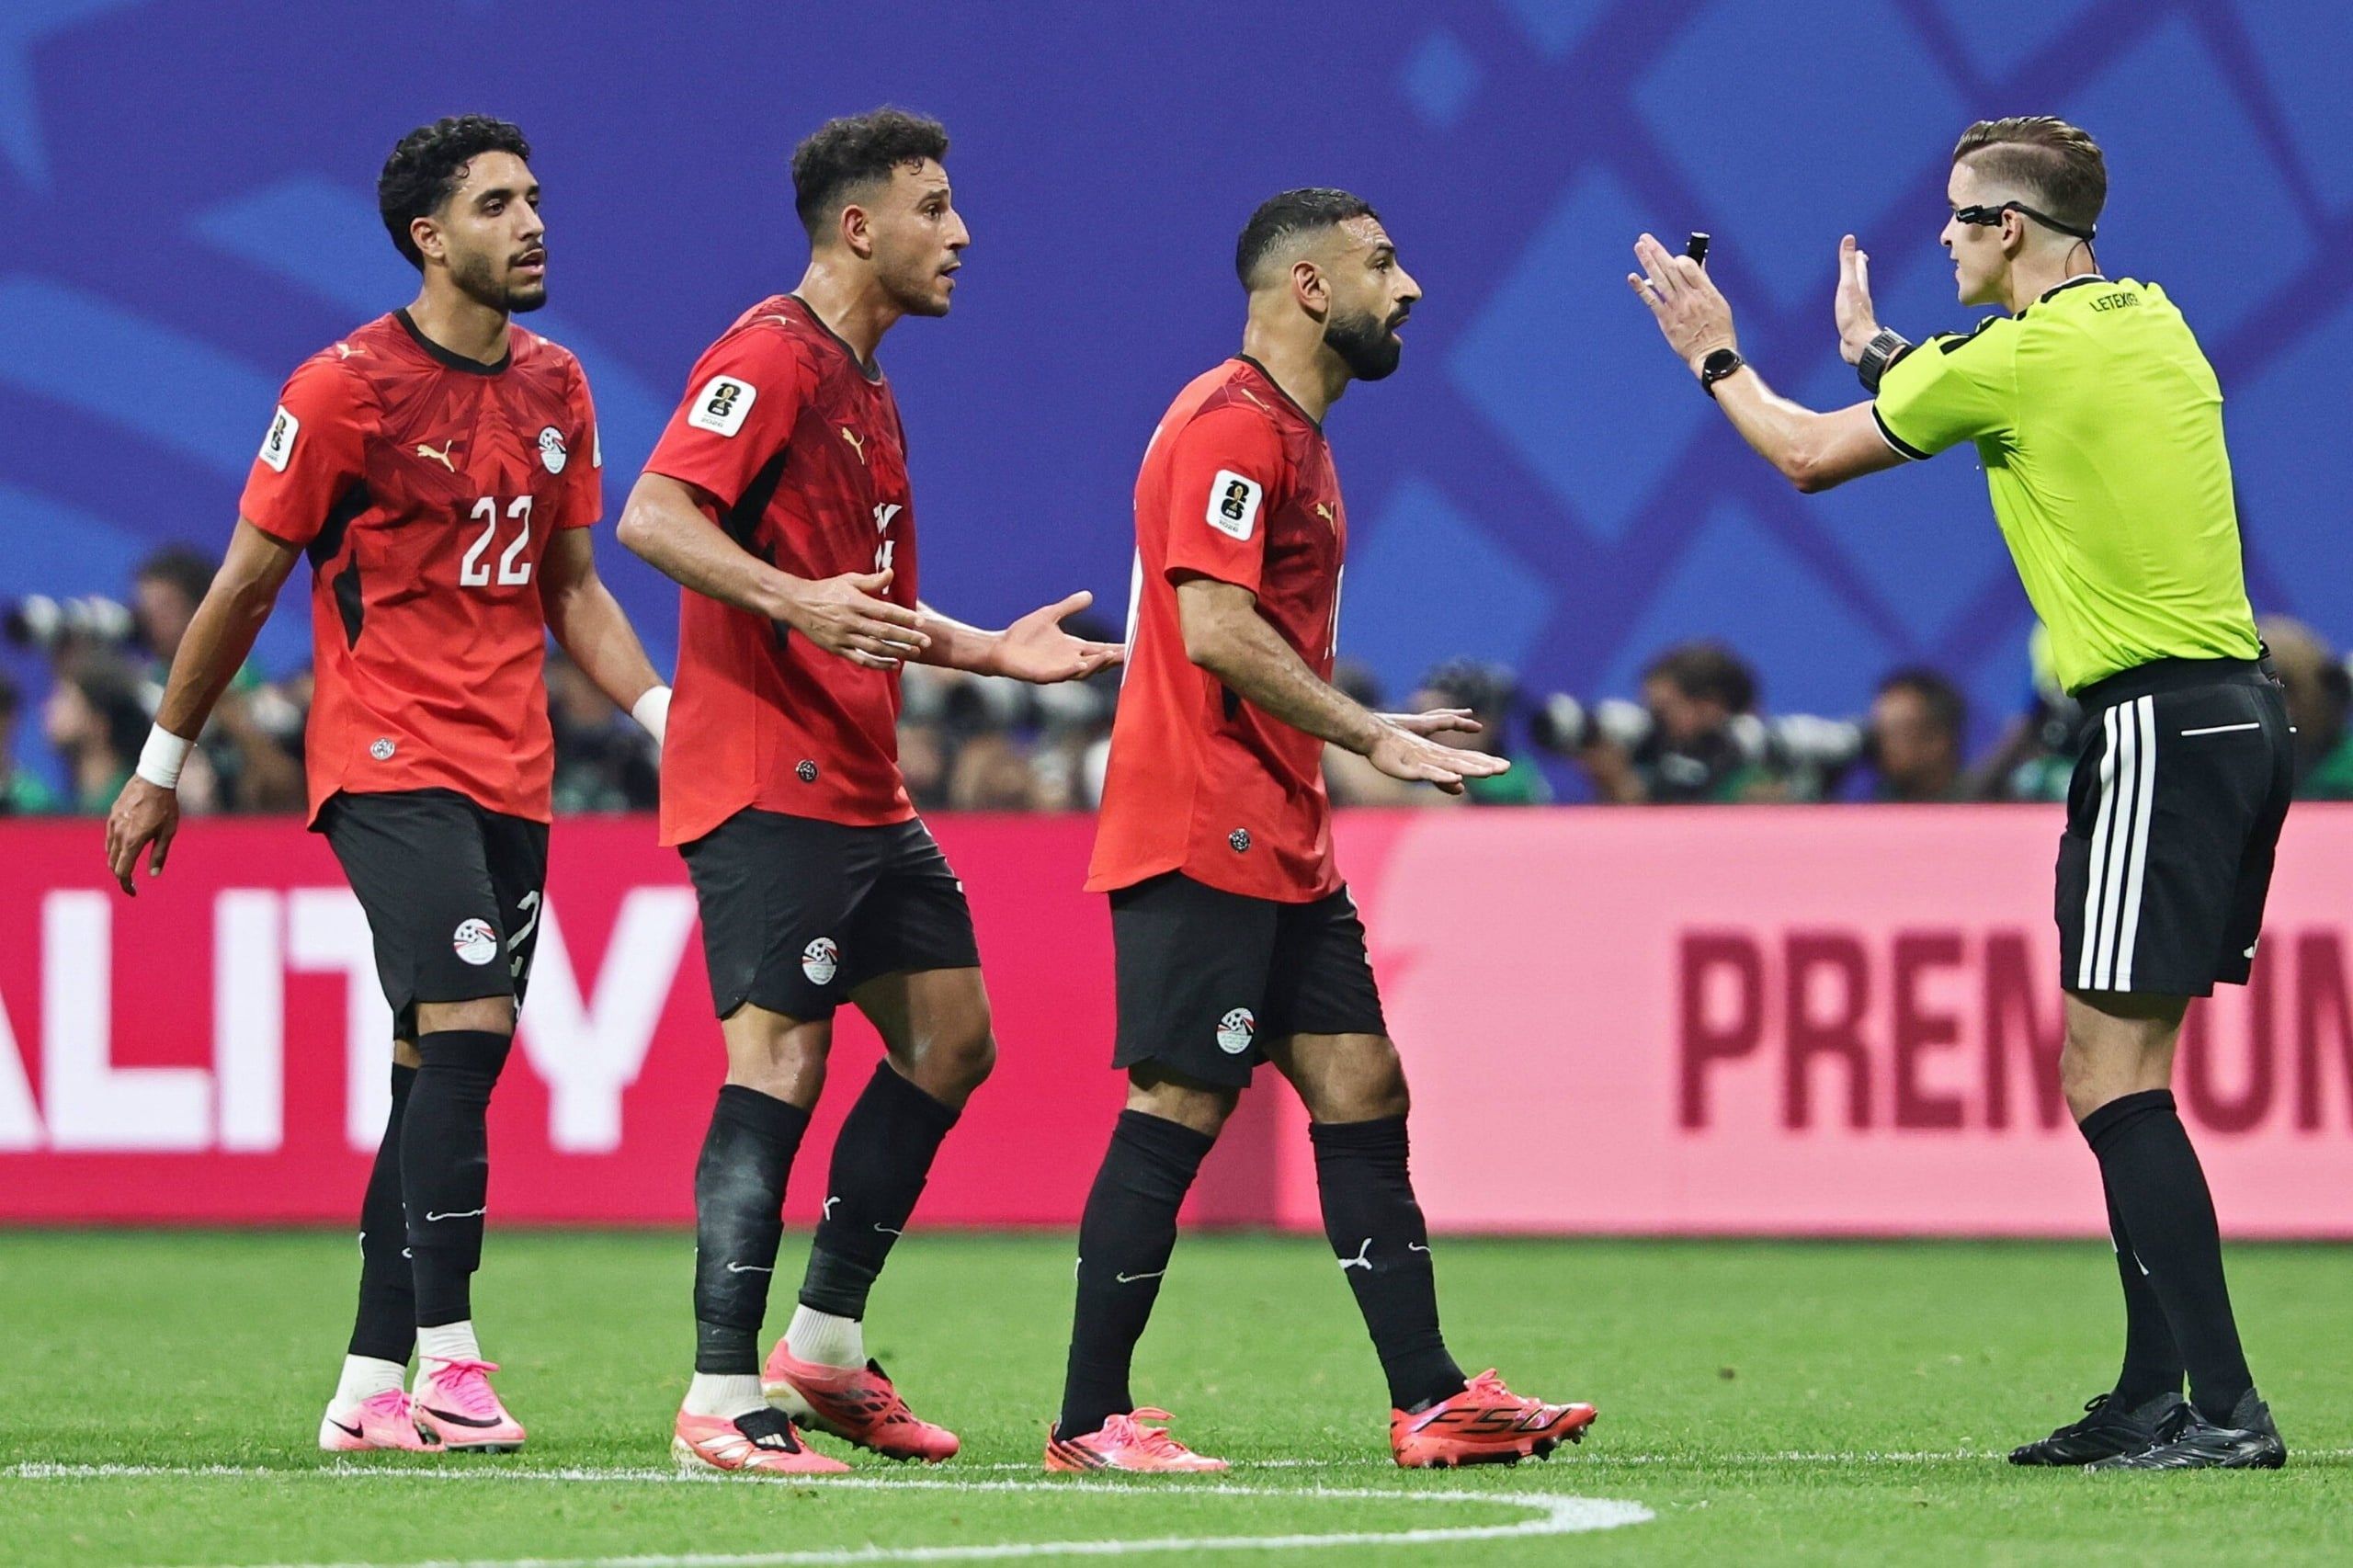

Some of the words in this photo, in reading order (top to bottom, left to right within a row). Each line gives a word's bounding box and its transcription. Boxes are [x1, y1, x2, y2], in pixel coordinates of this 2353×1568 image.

[460, 495, 533, 586] 22
[0, 887, 698, 1153] LITY
[1678, 930, 2353, 1133] PREMU
